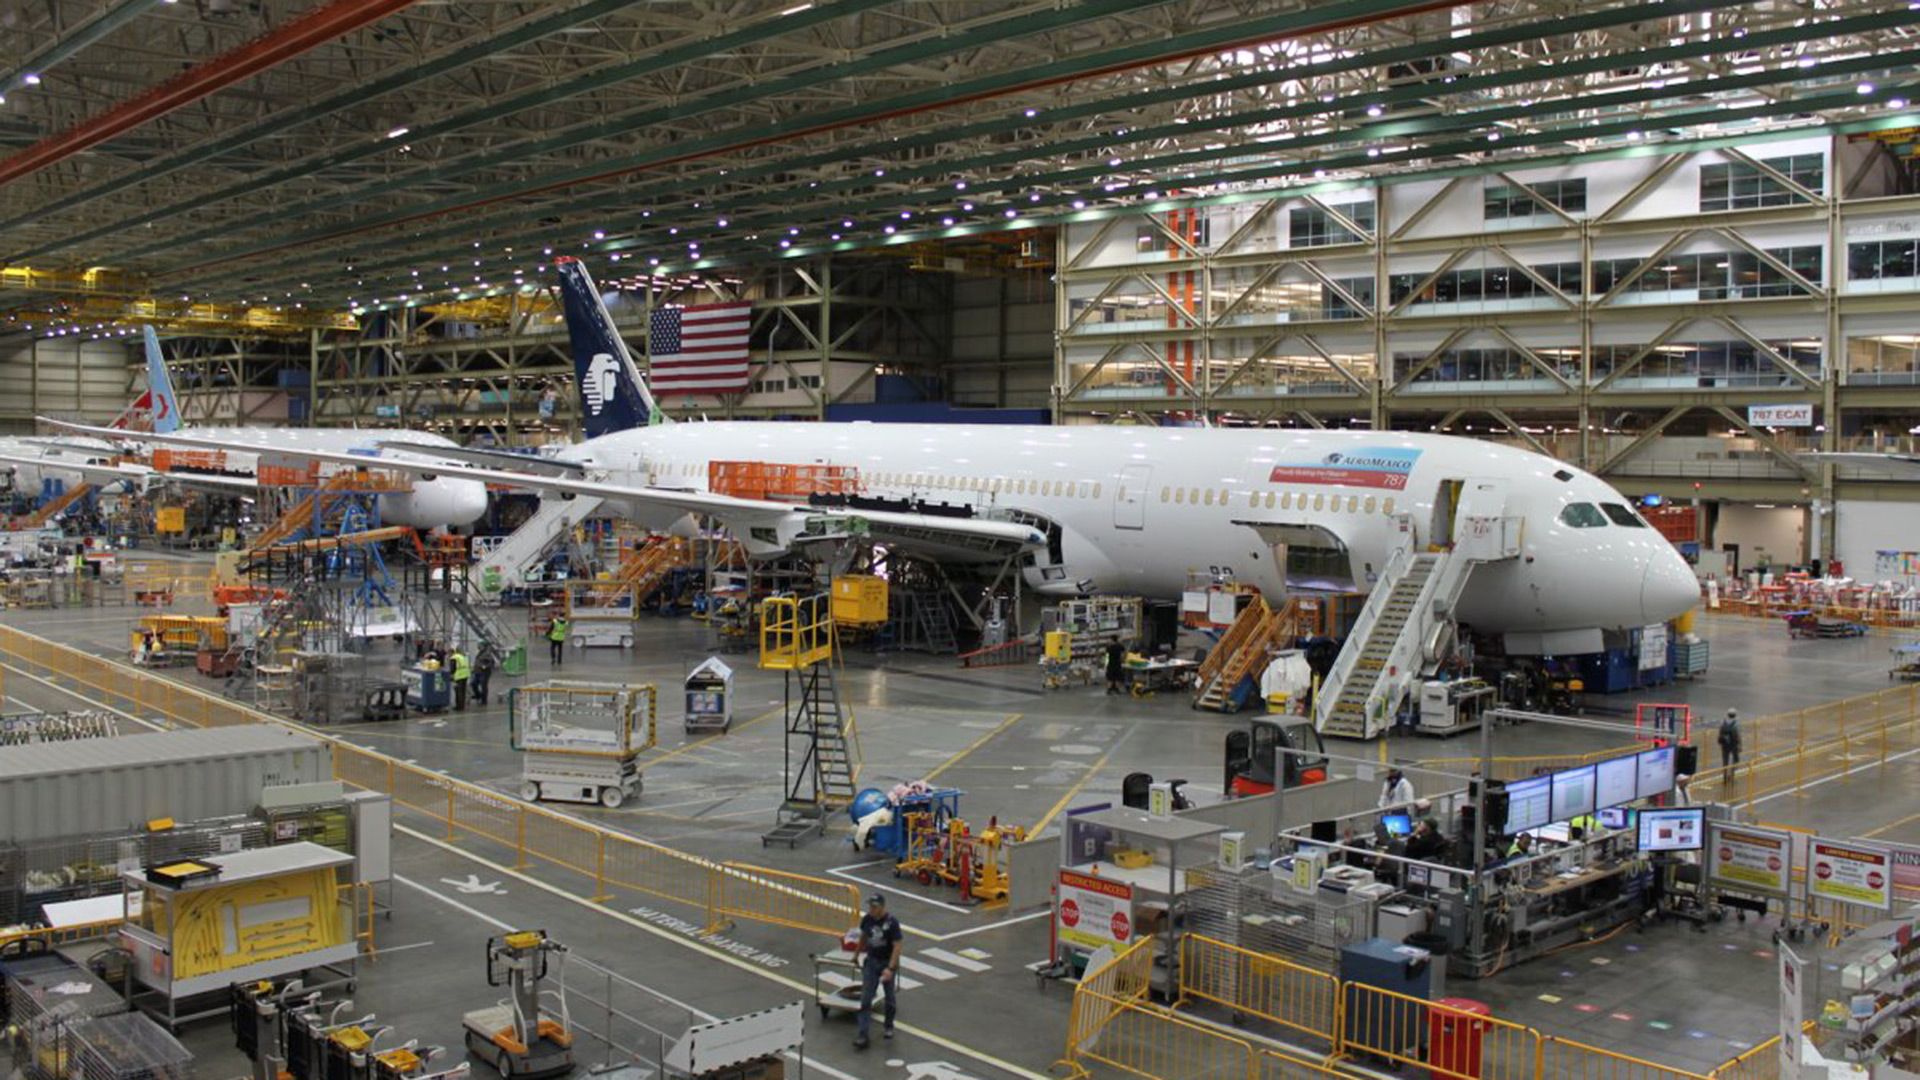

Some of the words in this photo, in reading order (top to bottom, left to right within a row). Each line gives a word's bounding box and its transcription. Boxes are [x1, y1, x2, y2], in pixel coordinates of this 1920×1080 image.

[1753, 410, 1772, 419] 787
[1776, 410, 1808, 419] ECAT
[1383, 474, 1407, 486] 787
[1895, 852, 1920, 866] NIN
[1103, 882, 1129, 897] ACCESS
[1061, 906, 1079, 918] STOP
[1112, 919, 1129, 931] STOP
